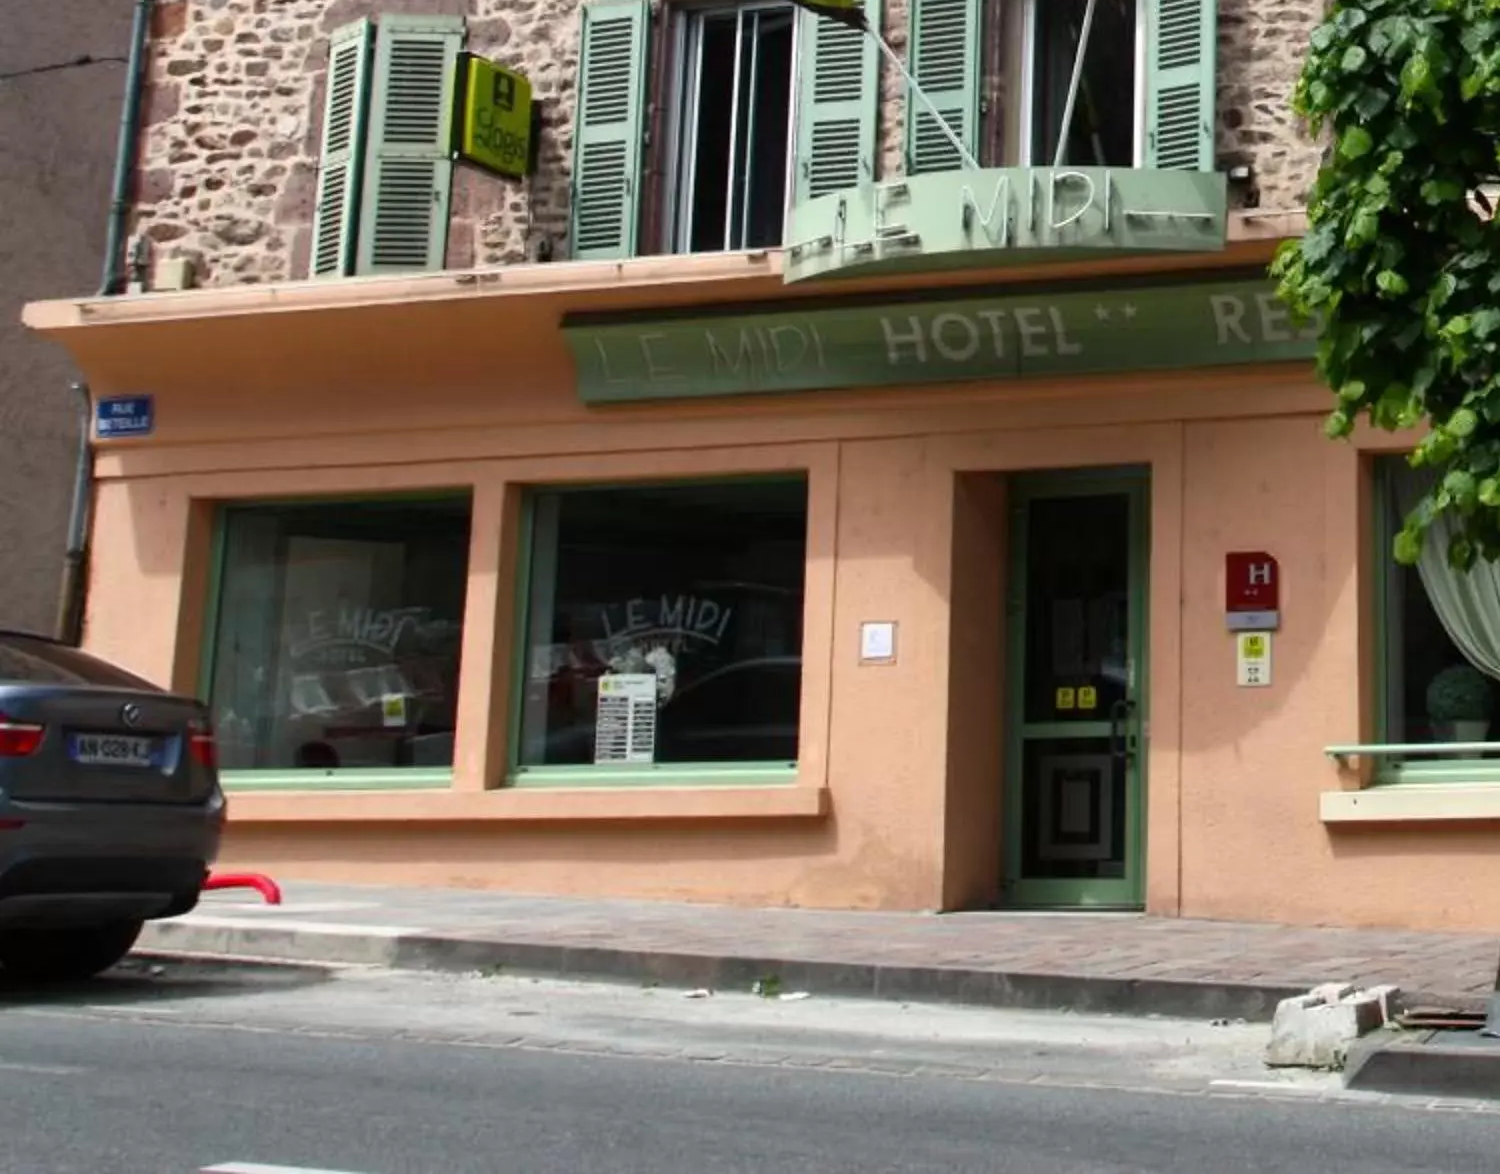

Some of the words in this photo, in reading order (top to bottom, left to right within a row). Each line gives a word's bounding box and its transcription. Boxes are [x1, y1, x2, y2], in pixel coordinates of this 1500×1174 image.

[962, 169, 1112, 248] MIDI
[704, 322, 828, 378] MIDI
[880, 304, 1083, 365] HOTEL
[1248, 562, 1271, 586] H
[659, 593, 732, 637] MIDI
